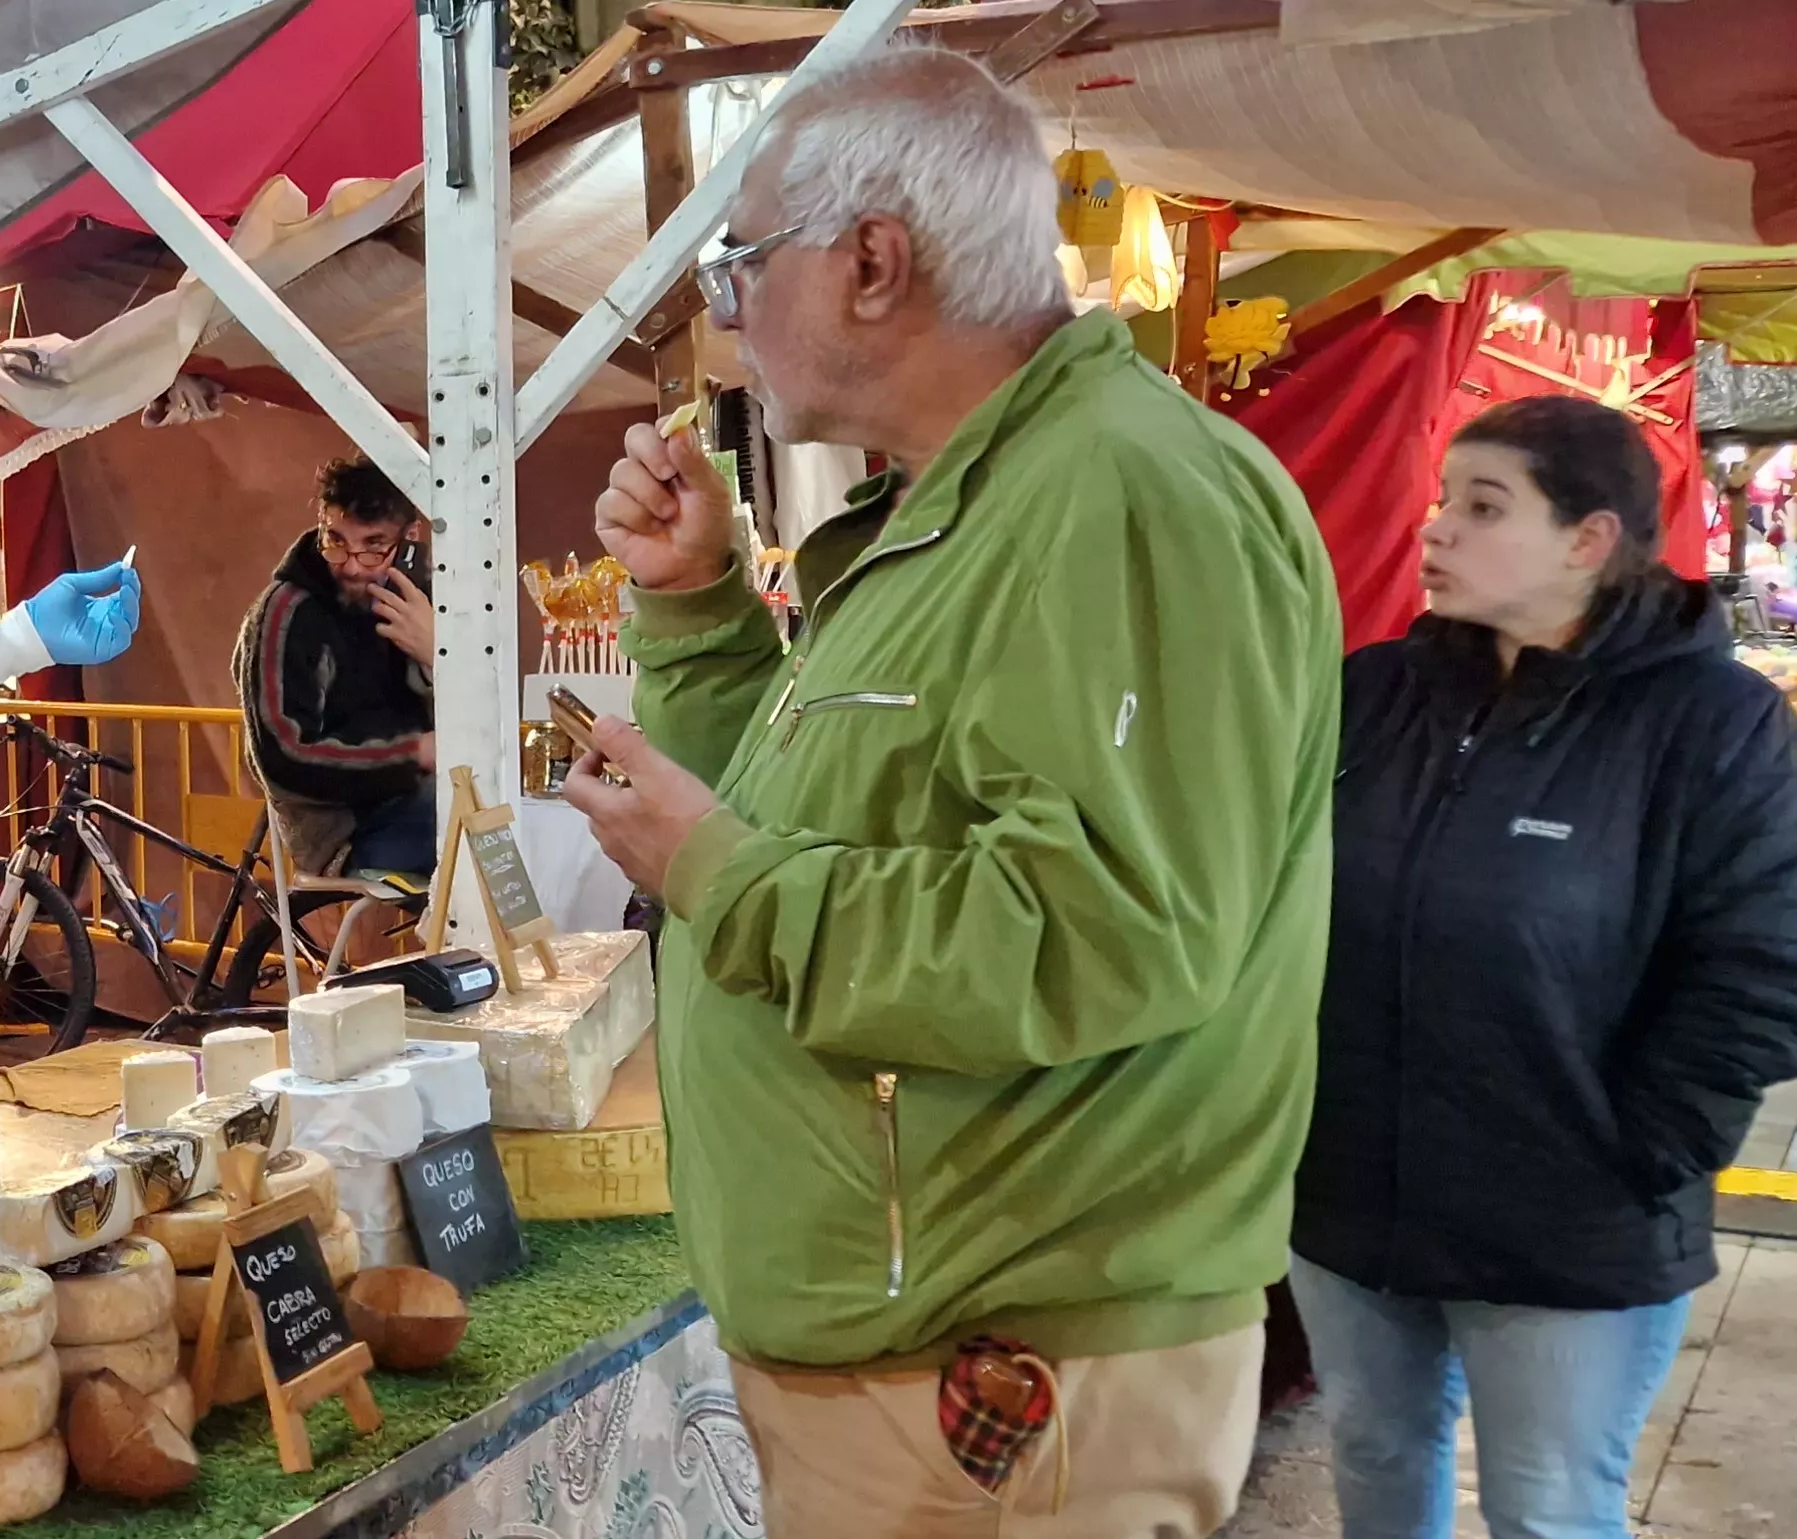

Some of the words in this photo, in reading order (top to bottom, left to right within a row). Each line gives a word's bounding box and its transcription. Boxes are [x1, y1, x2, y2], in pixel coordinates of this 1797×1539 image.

[422, 1149, 475, 1187] QUESO
[448, 1184, 476, 1212] CON
[438, 1211, 486, 1252] TRUFA
[267, 1285, 317, 1324] CABRA
